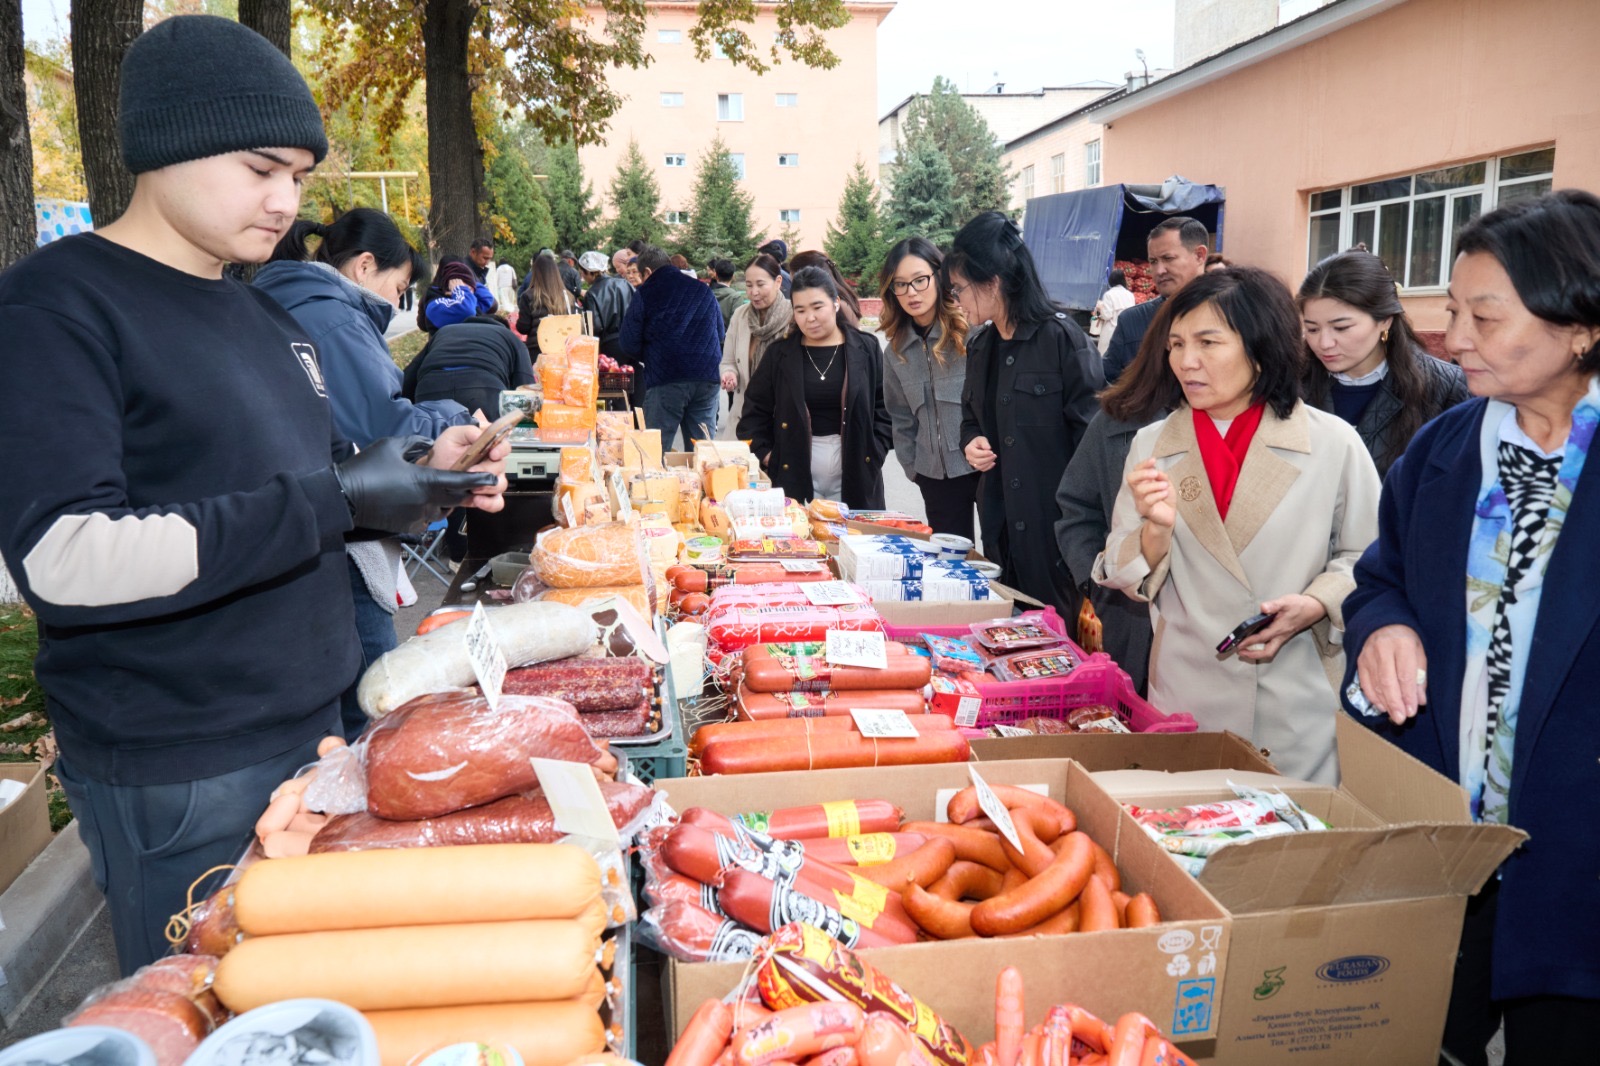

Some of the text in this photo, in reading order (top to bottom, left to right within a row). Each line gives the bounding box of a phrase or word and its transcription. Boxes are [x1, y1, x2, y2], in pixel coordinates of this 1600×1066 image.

[1328, 959, 1378, 970] EURASIAN
[1337, 967, 1369, 978] FOODS
[1297, 1034, 1317, 1045] (727)
[1334, 1031, 1342, 1040] 71
[1344, 1030, 1353, 1039] 71
